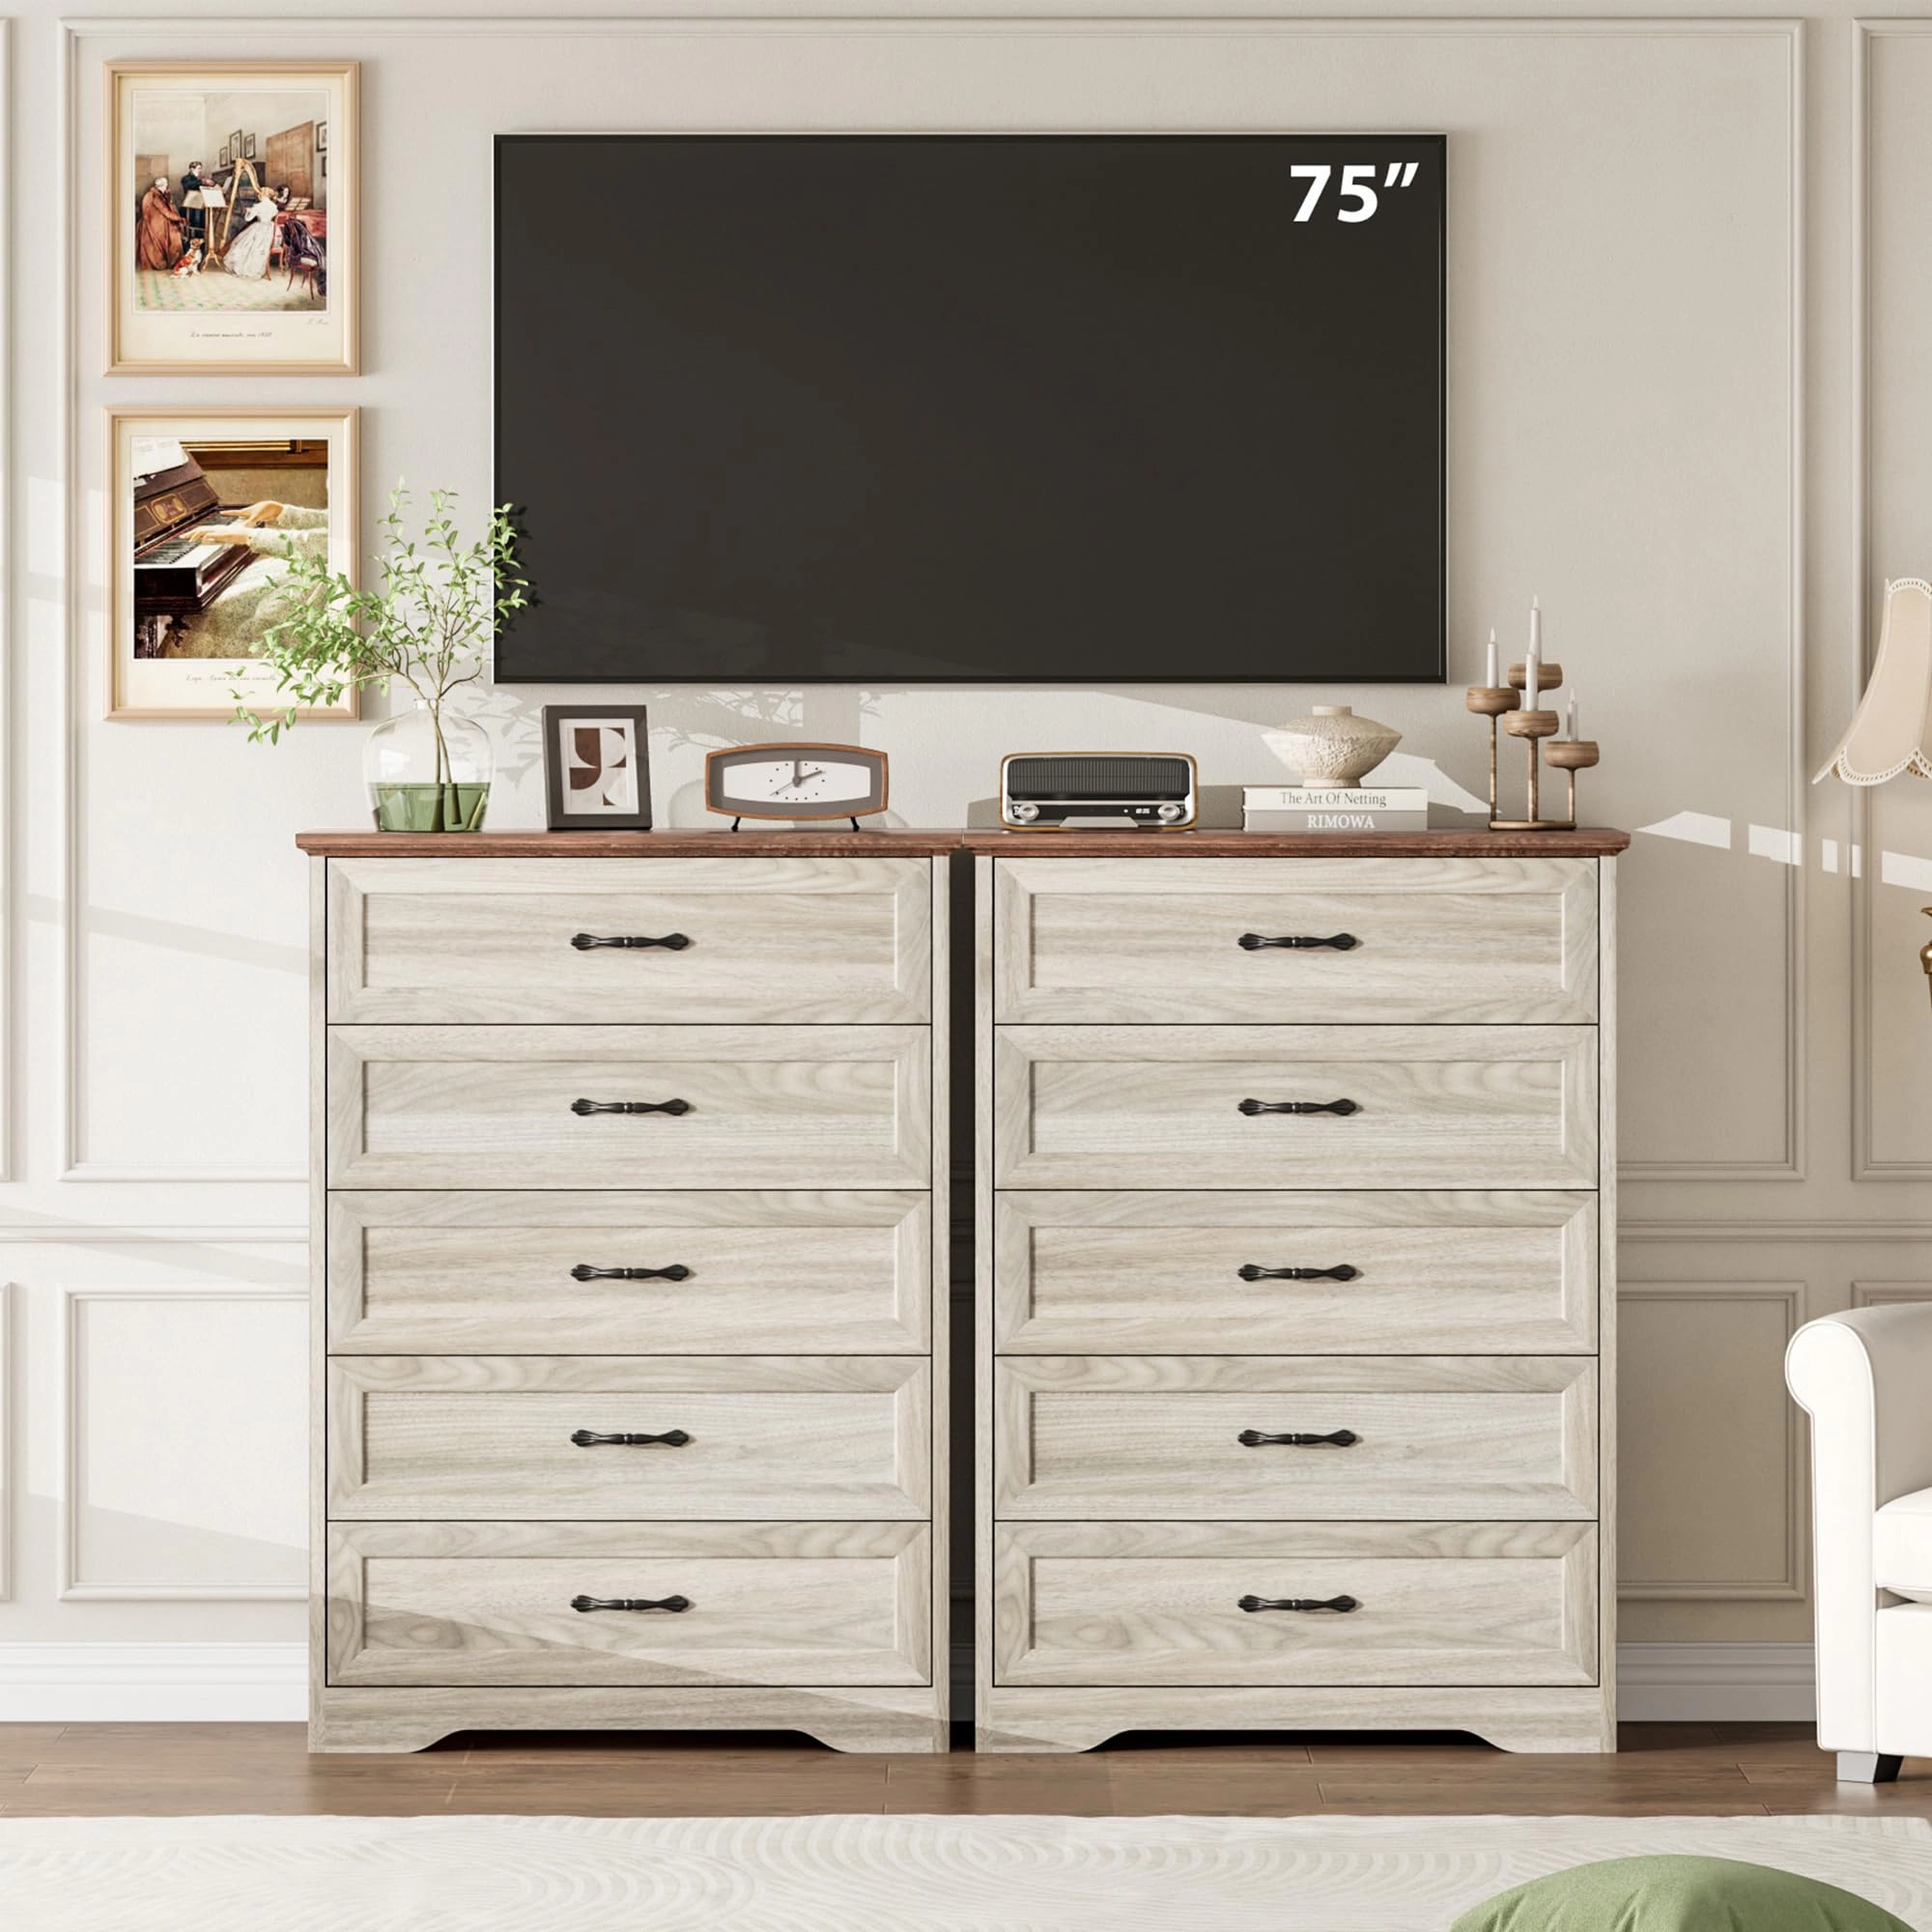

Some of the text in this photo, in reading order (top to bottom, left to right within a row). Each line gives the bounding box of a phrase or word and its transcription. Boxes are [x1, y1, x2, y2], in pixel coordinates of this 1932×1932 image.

[1281, 791, 1387, 809] The Art Of Netting
[1306, 814, 1376, 829] RIMOWA
